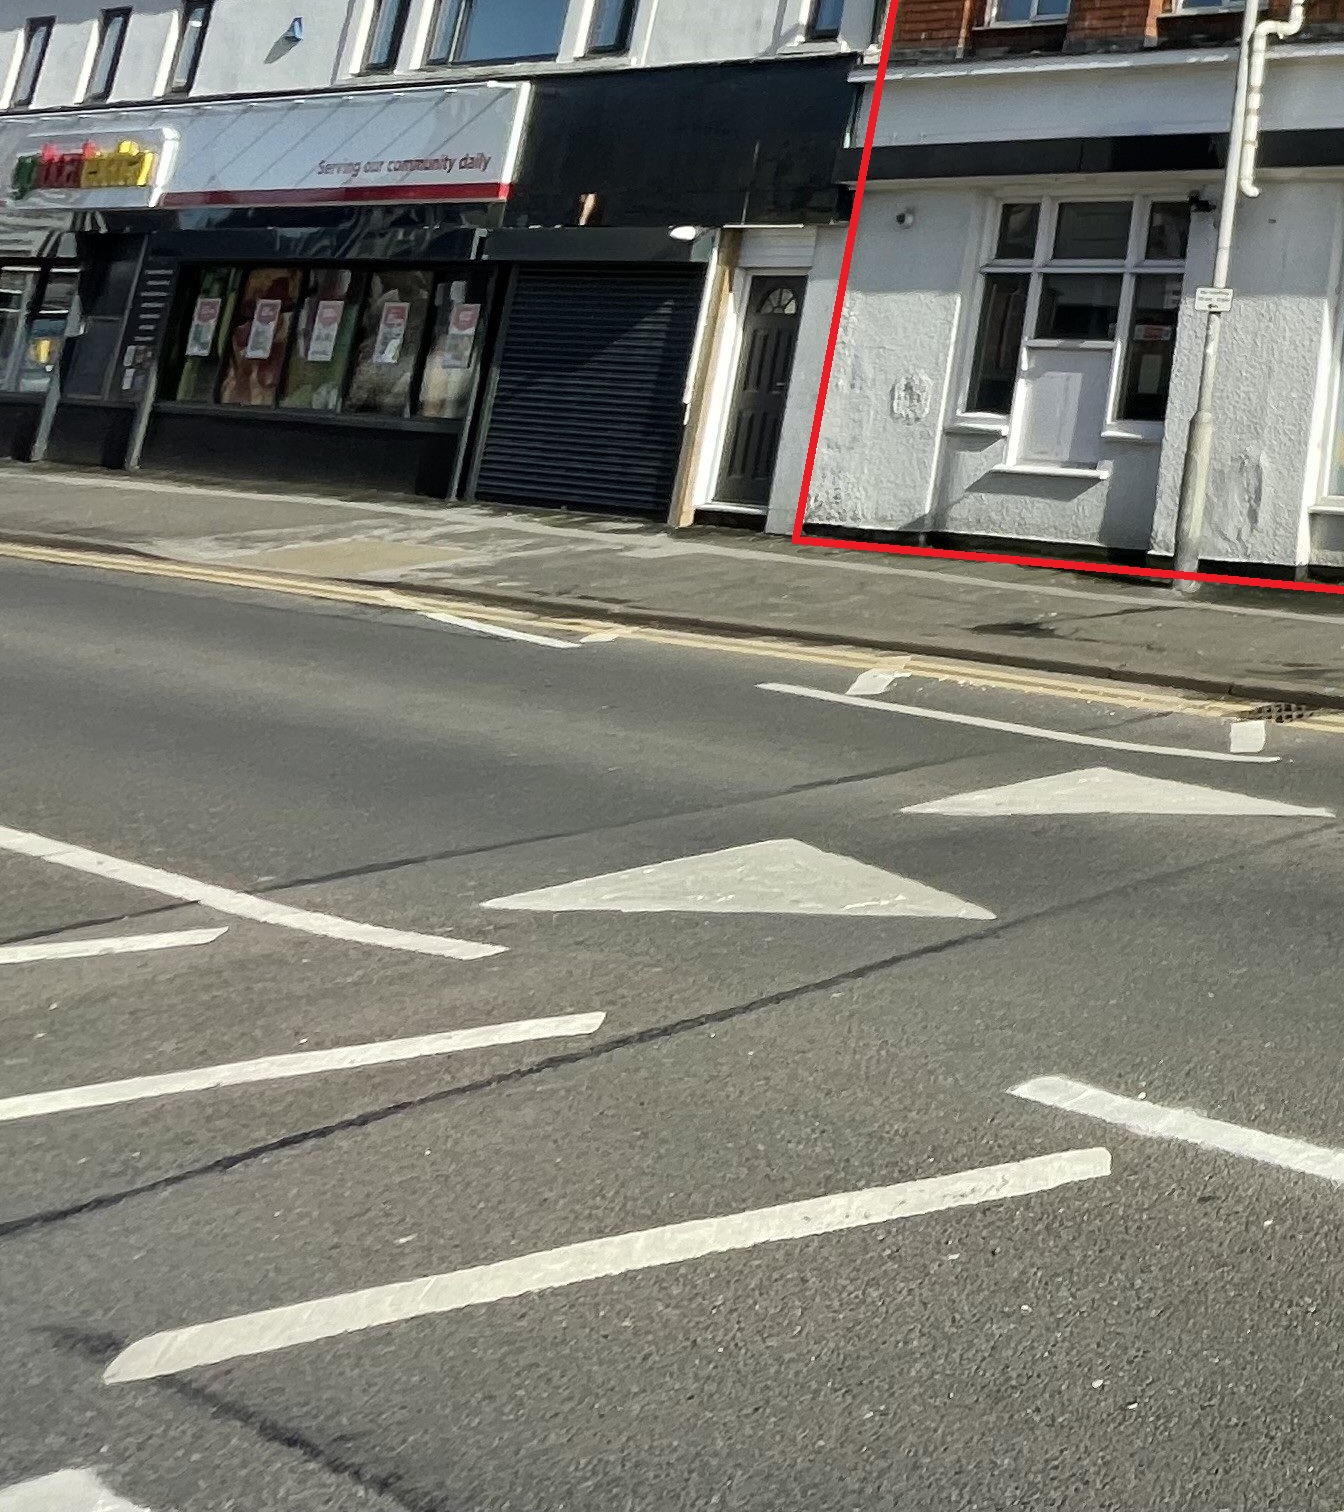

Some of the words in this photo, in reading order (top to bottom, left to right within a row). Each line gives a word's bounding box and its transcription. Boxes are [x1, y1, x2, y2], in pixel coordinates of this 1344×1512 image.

[317, 159, 362, 177] Serving
[363, 160, 384, 174] our
[387, 154, 457, 173] community
[458, 152, 492, 172] daily
